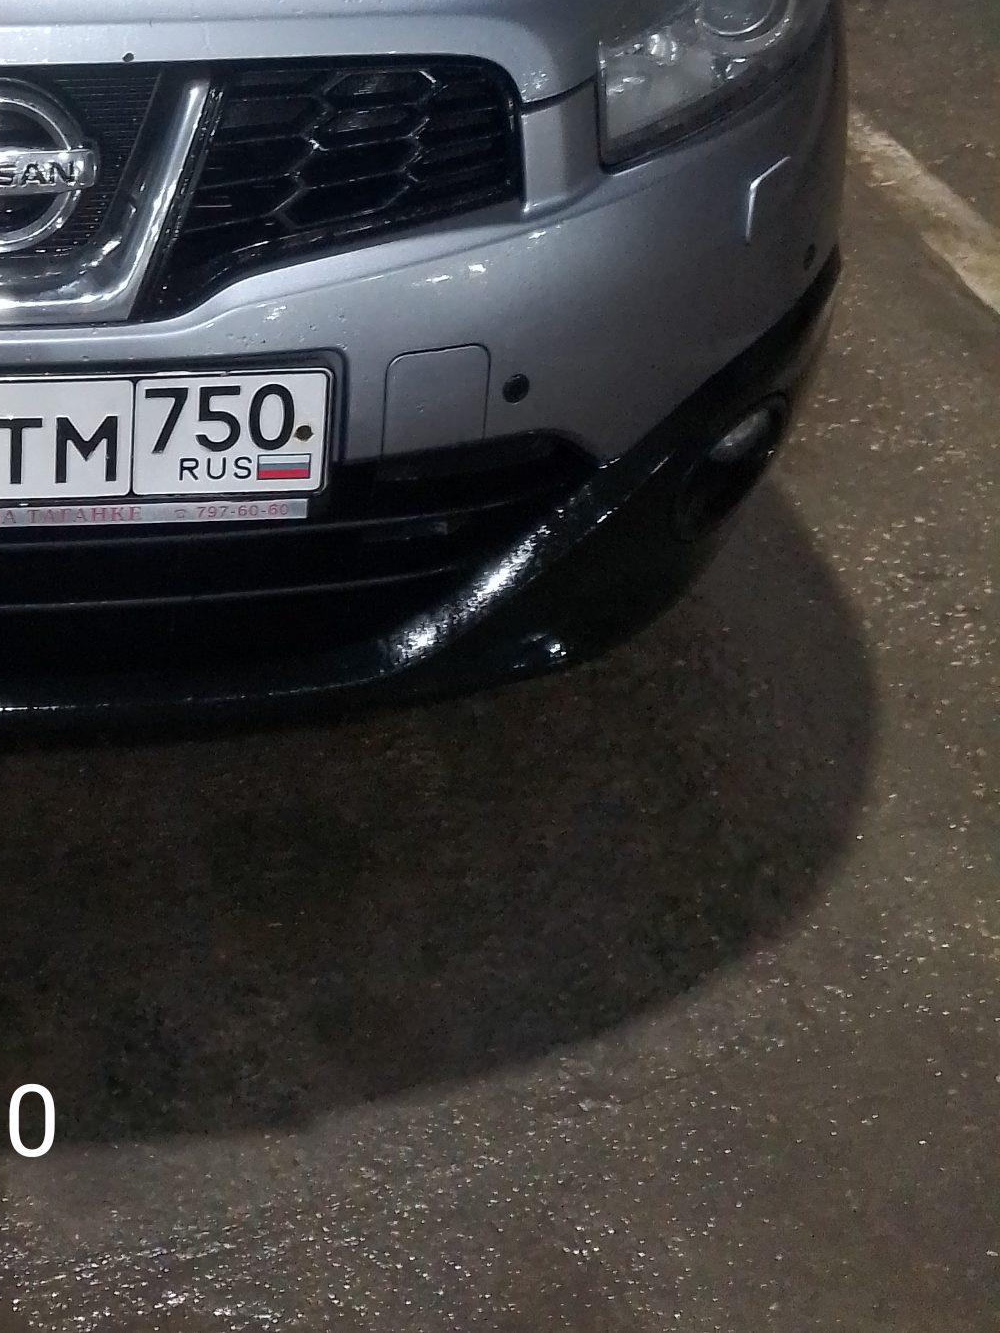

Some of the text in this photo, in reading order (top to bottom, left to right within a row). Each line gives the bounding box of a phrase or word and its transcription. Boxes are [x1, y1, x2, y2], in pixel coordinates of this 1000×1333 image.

[144, 384, 296, 454] 750
[179, 455, 252, 480] RUS
[27, 506, 142, 524] ТАГАНКЕ
[197, 503, 289, 519] 797-60-60
